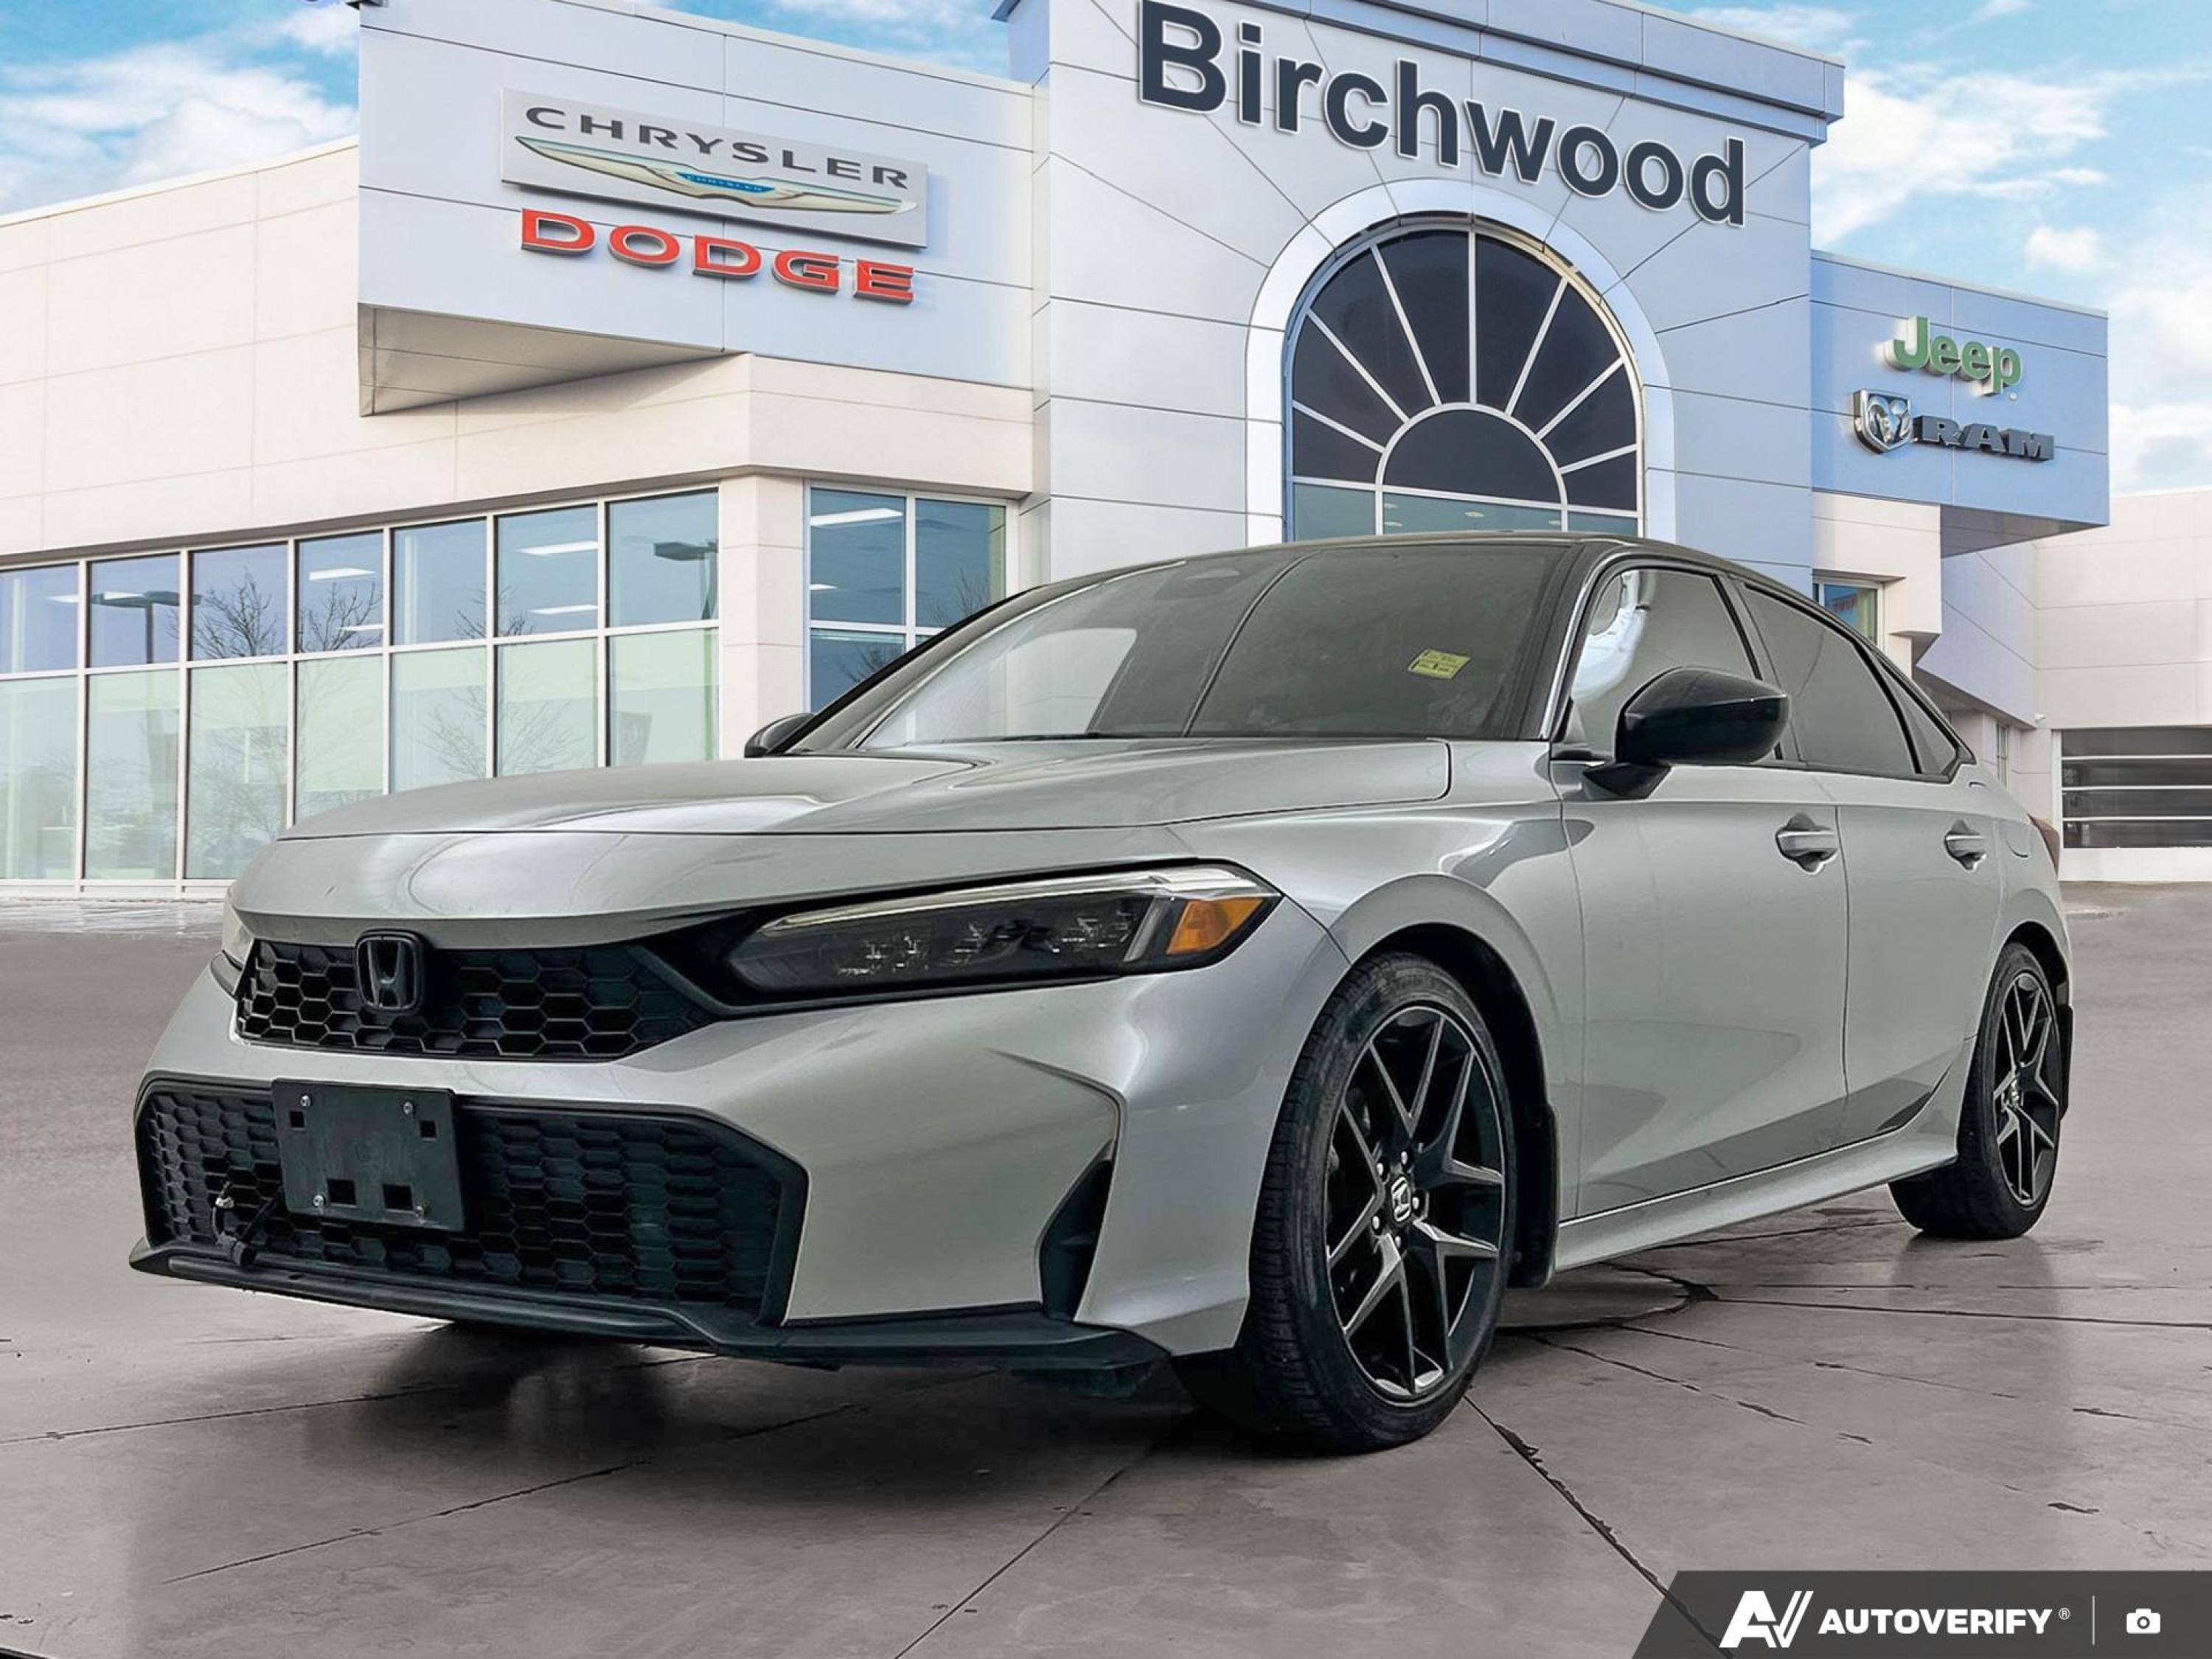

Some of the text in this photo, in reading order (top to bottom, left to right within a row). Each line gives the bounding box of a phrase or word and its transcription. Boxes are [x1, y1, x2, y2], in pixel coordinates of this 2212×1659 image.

[525, 106, 908, 189] CHRYSLER
[1139, 0, 1746, 226] Birchwood
[521, 208, 914, 305] DODGE
[1884, 316, 2022, 396] Jeep
[1913, 415, 2055, 462] RAM
